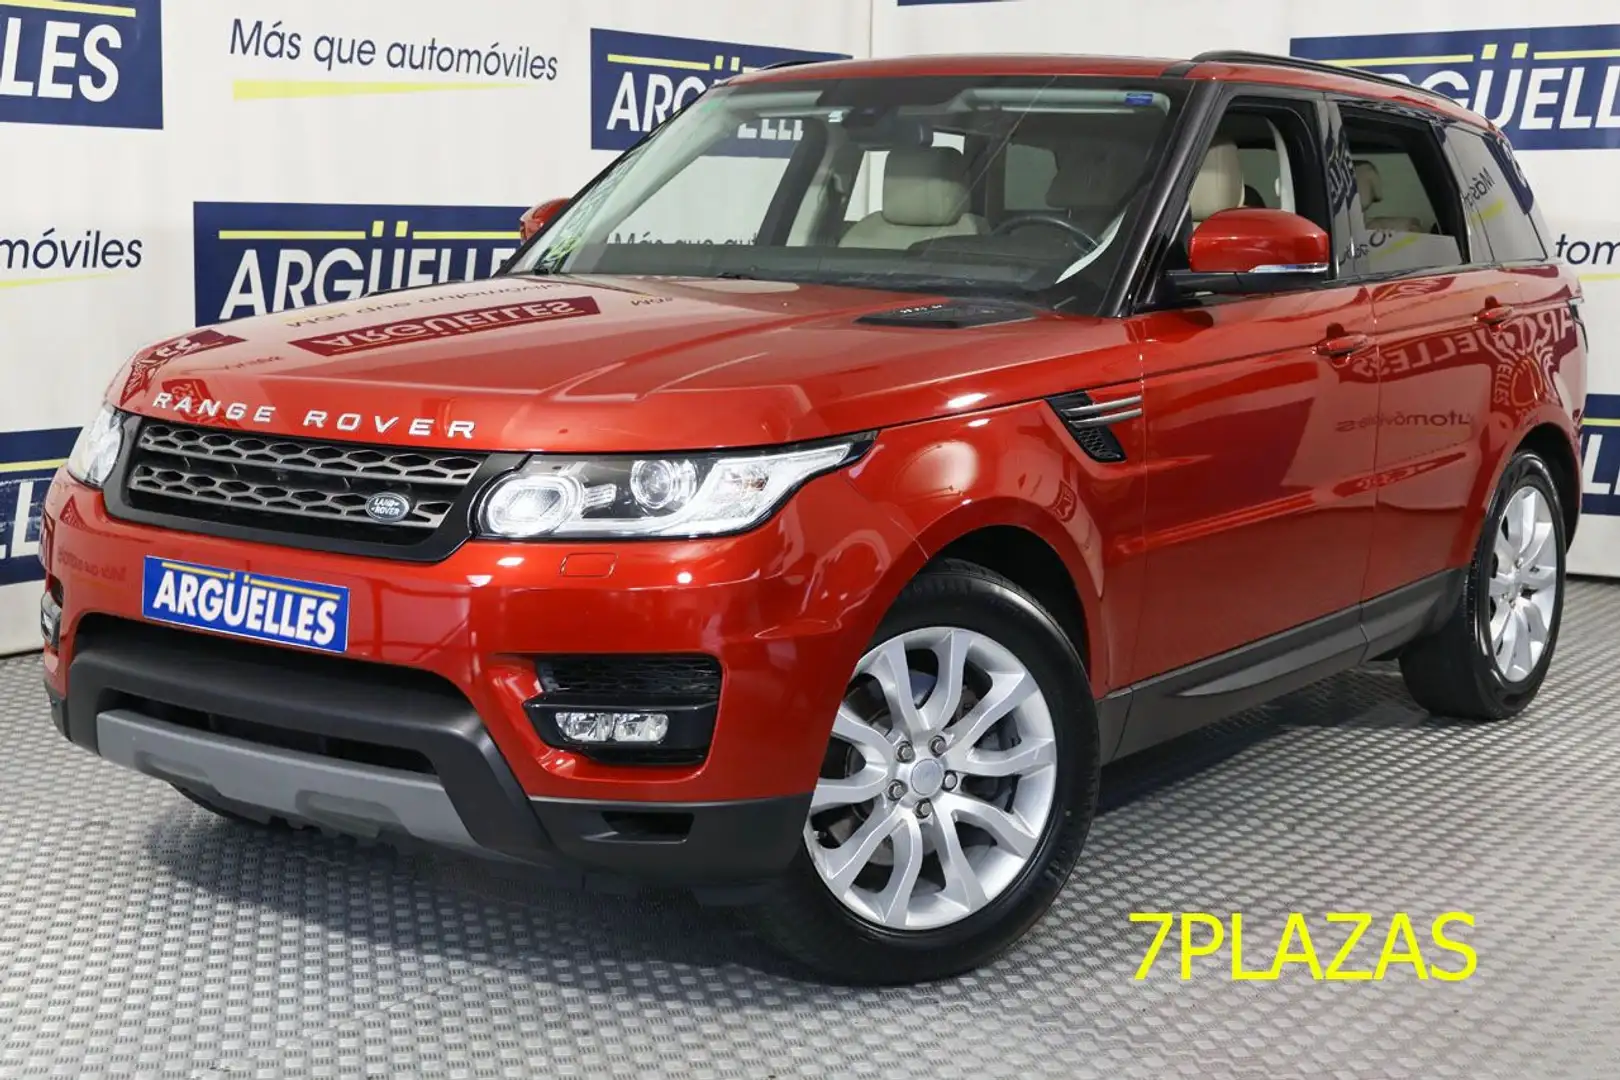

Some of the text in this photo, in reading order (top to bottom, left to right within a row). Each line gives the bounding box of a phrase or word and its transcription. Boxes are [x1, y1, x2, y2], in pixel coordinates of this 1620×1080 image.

[230, 18, 558, 80] Más que automóviles
[0, 227, 143, 269] móviles
[152, 391, 477, 440] RANGE ROVER
[152, 570, 338, 646] ARGÜELLES
